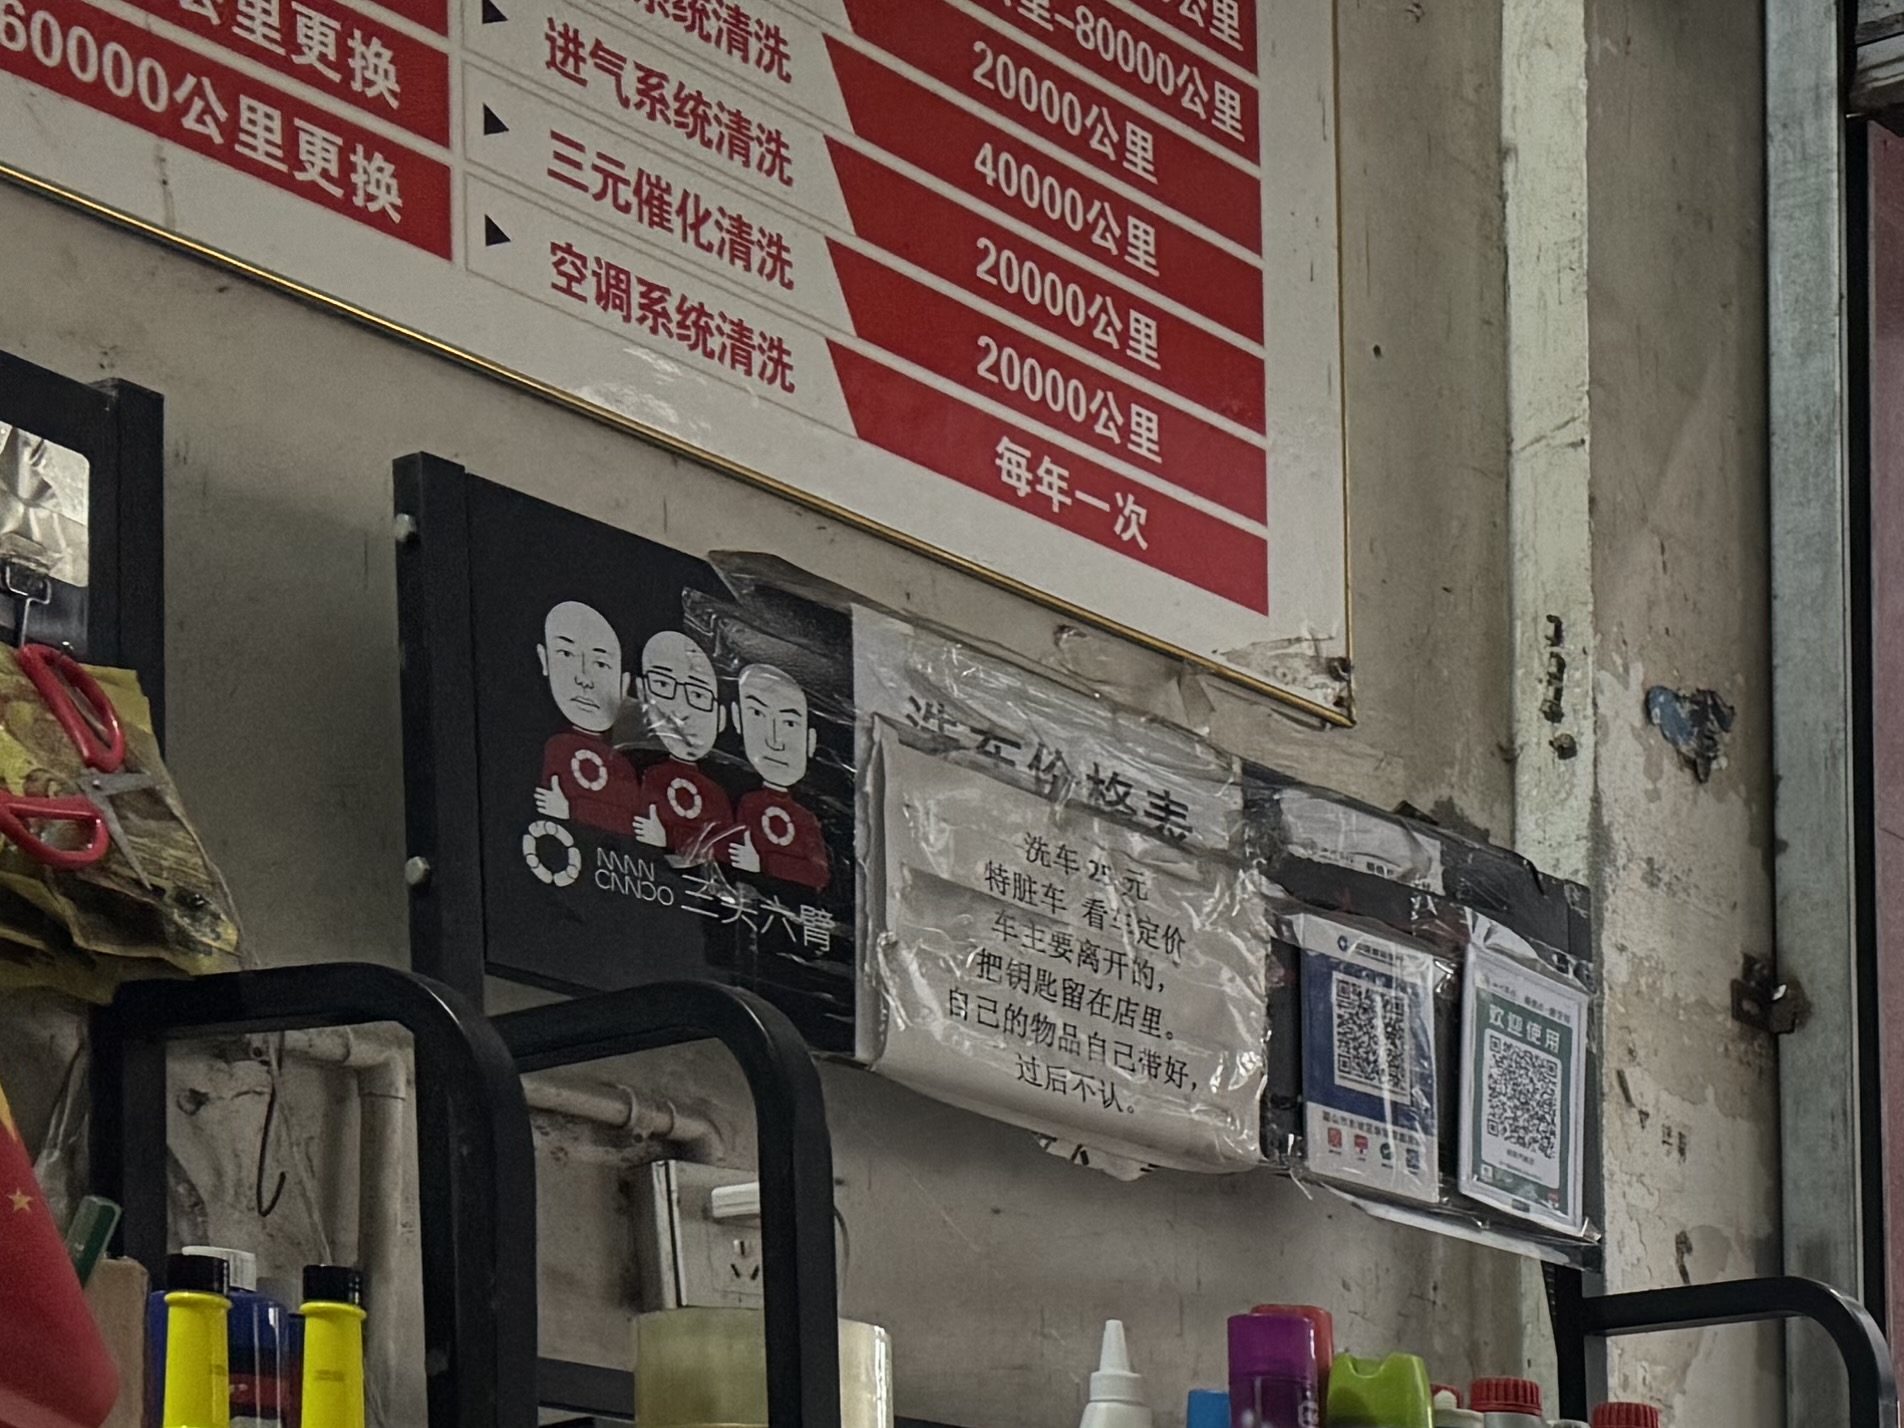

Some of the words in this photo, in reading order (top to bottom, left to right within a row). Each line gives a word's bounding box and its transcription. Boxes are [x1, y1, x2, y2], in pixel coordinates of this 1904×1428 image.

[545, 17, 794, 187] 进气系统清洗
[973, 41, 1158, 184] 20000公里
[547, 129, 795, 291] 三元催化清洗
[974, 142, 1159, 279] 40000公里
[549, 241, 797, 394] 空调系统清洗
[976, 236, 1161, 372] 20000公里
[976, 335, 1162, 464] 20000公里
[995, 437, 1151, 550] 每年一次
[984, 859, 1069, 915] 特脏车
[1024, 831, 1080, 877] 洗车
[1123, 868, 1150, 901] 元
[975, 947, 1177, 1041] 把钥匙留在店里。
[1488, 1003, 1561, 1054] 欢迎使用
[1015, 1053, 1135, 1115] 过后不认。
